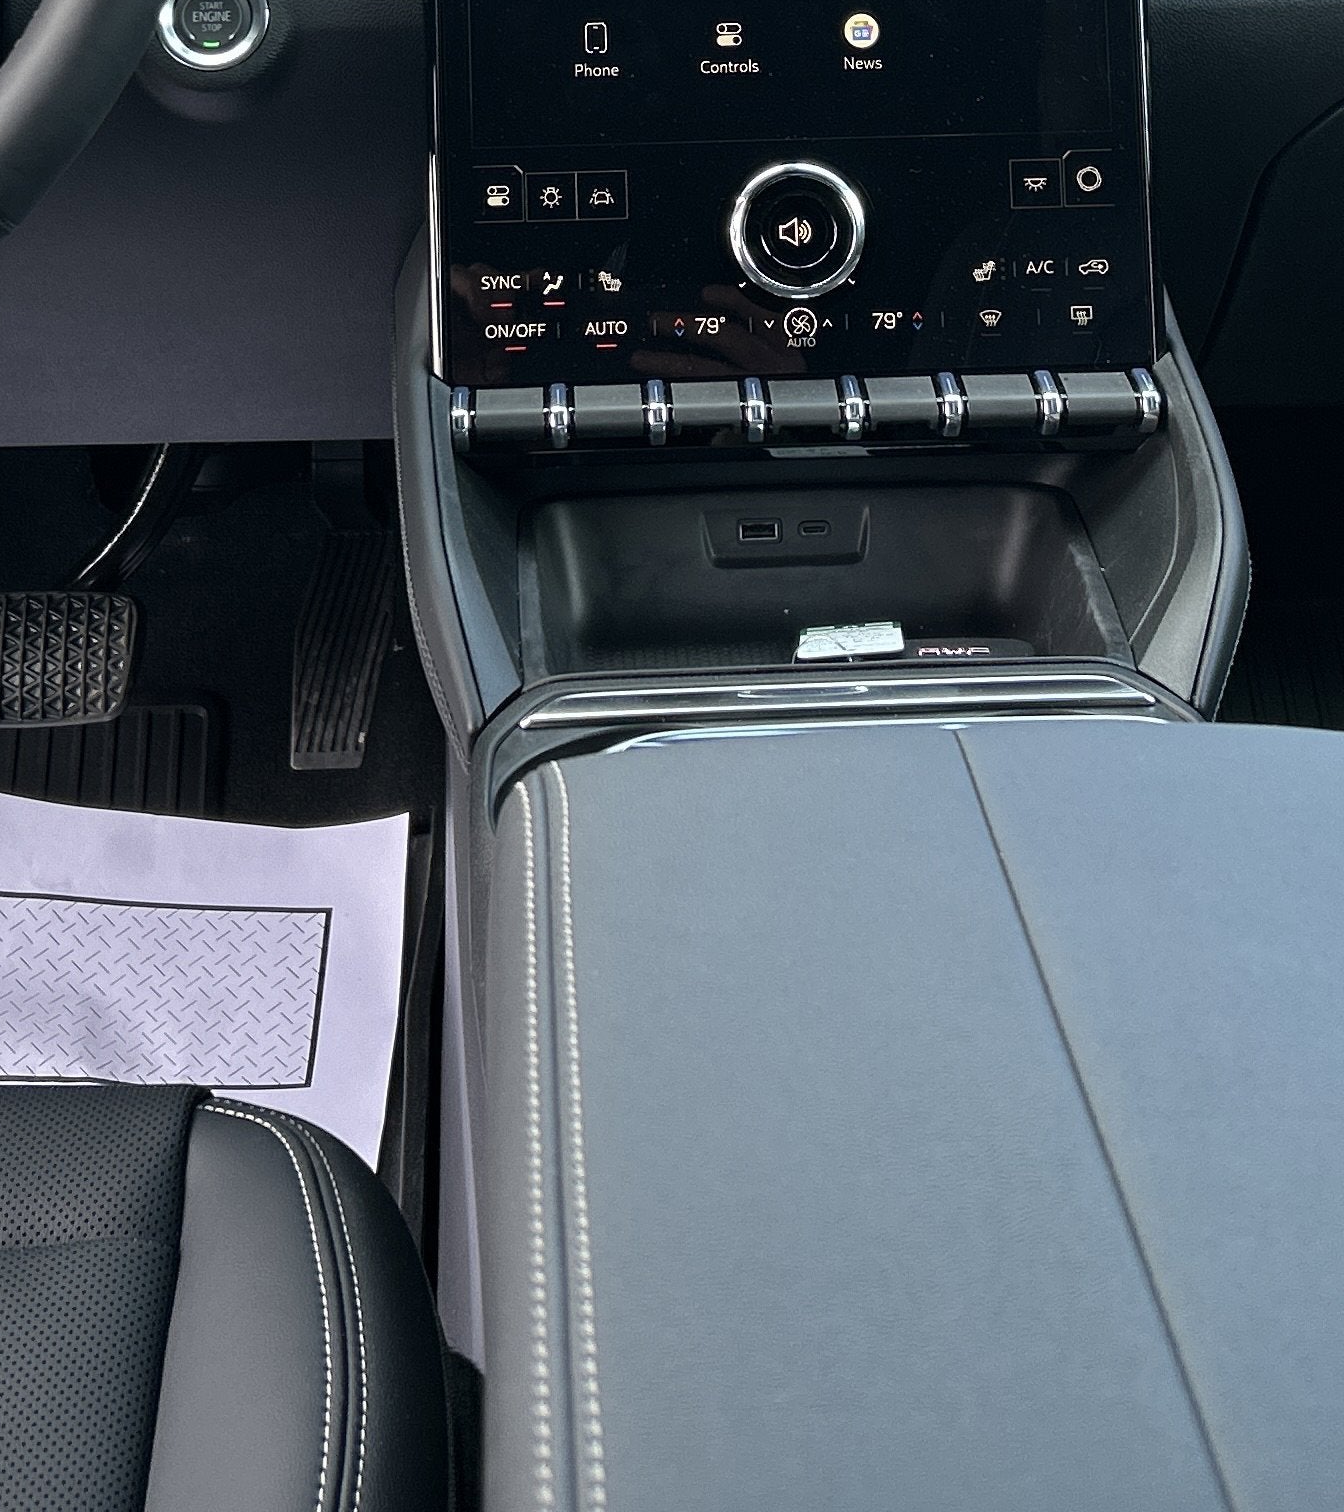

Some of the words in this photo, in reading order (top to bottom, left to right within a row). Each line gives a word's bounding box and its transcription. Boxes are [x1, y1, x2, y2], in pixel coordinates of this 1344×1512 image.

[199, 1, 223, 11] START
[192, 10, 231, 23] ENGINE
[201, 23, 222, 32] STOP
[574, 62, 620, 77] Phone
[700, 58, 760, 74] Controls
[843, 56, 883, 70] News
[1025, 259, 1055, 275] A/C
[480, 274, 522, 290] SYNC
[584, 320, 628, 336] AUTO
[694, 316, 726, 335] 79°
[871, 311, 903, 330] 79°
[484, 323, 547, 339] ON/OFF
[787, 337, 816, 348] AUTO
